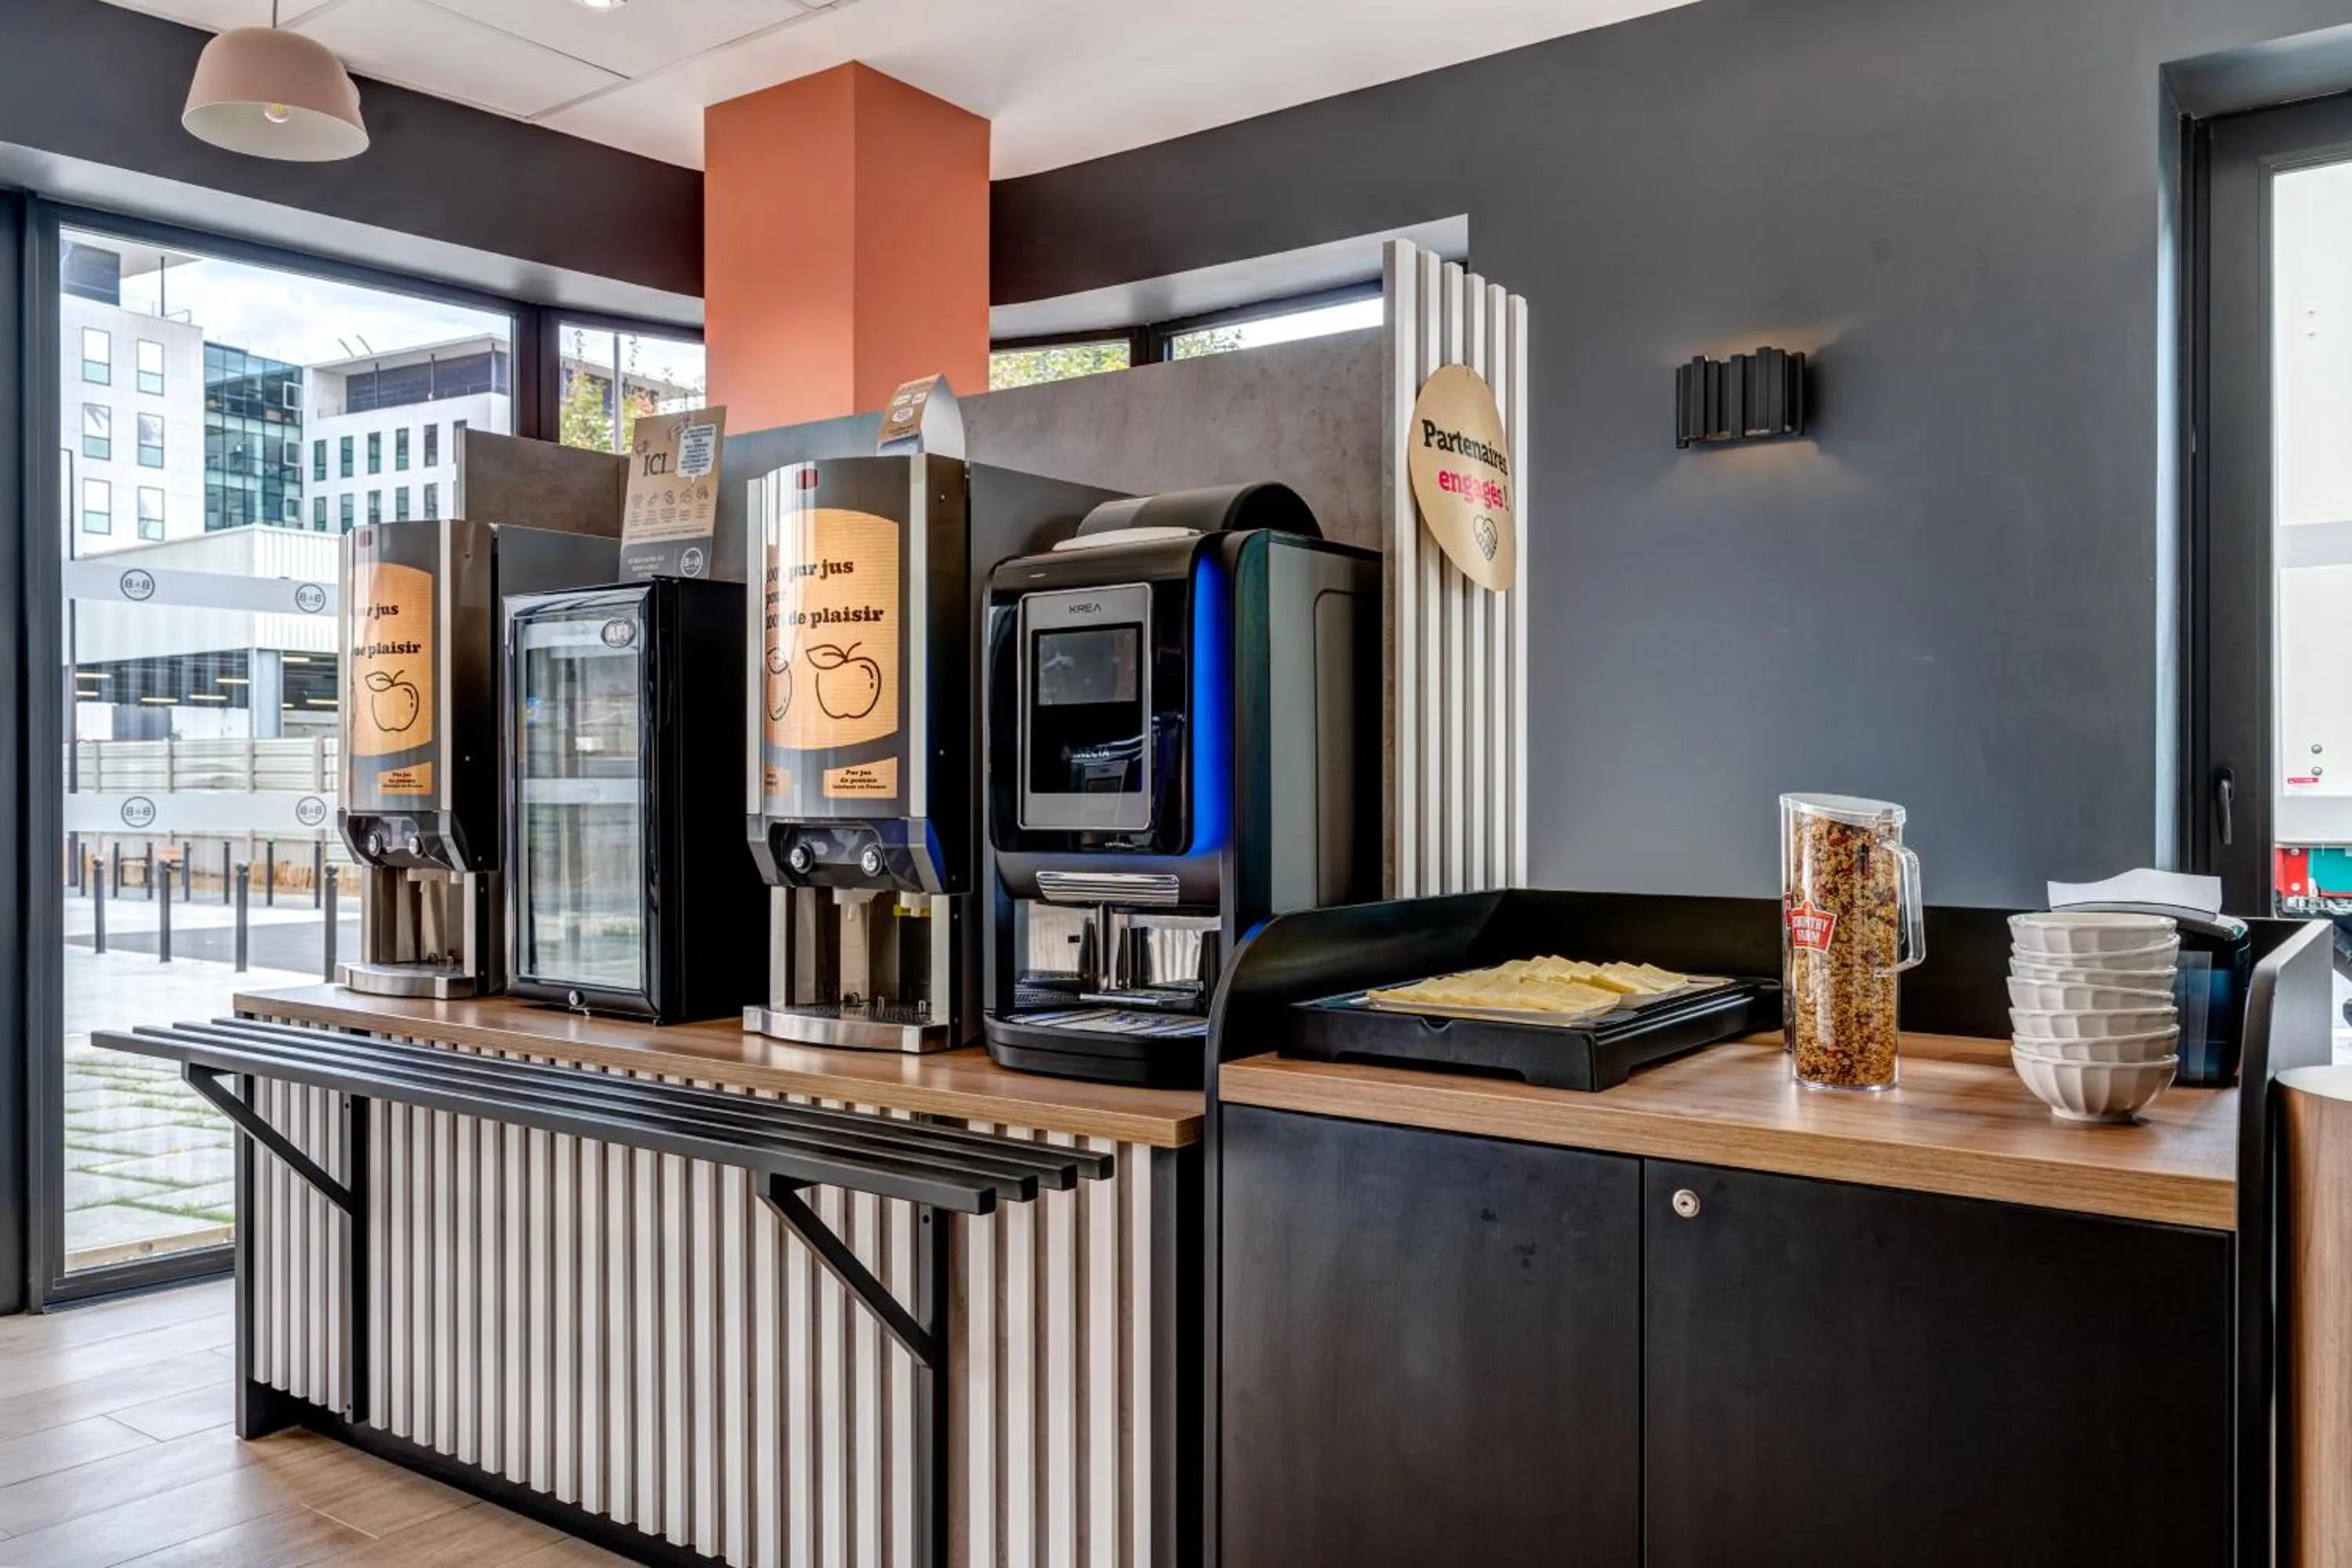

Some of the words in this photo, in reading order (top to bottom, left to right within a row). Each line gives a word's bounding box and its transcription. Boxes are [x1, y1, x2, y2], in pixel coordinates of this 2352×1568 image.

[1421, 418, 1508, 476] Partenaires
[819, 558, 854, 579] jus
[375, 602, 399, 620] jus
[811, 605, 884, 629] plaisir
[1069, 603, 1102, 615] KREA
[368, 641, 421, 659] plaisir
